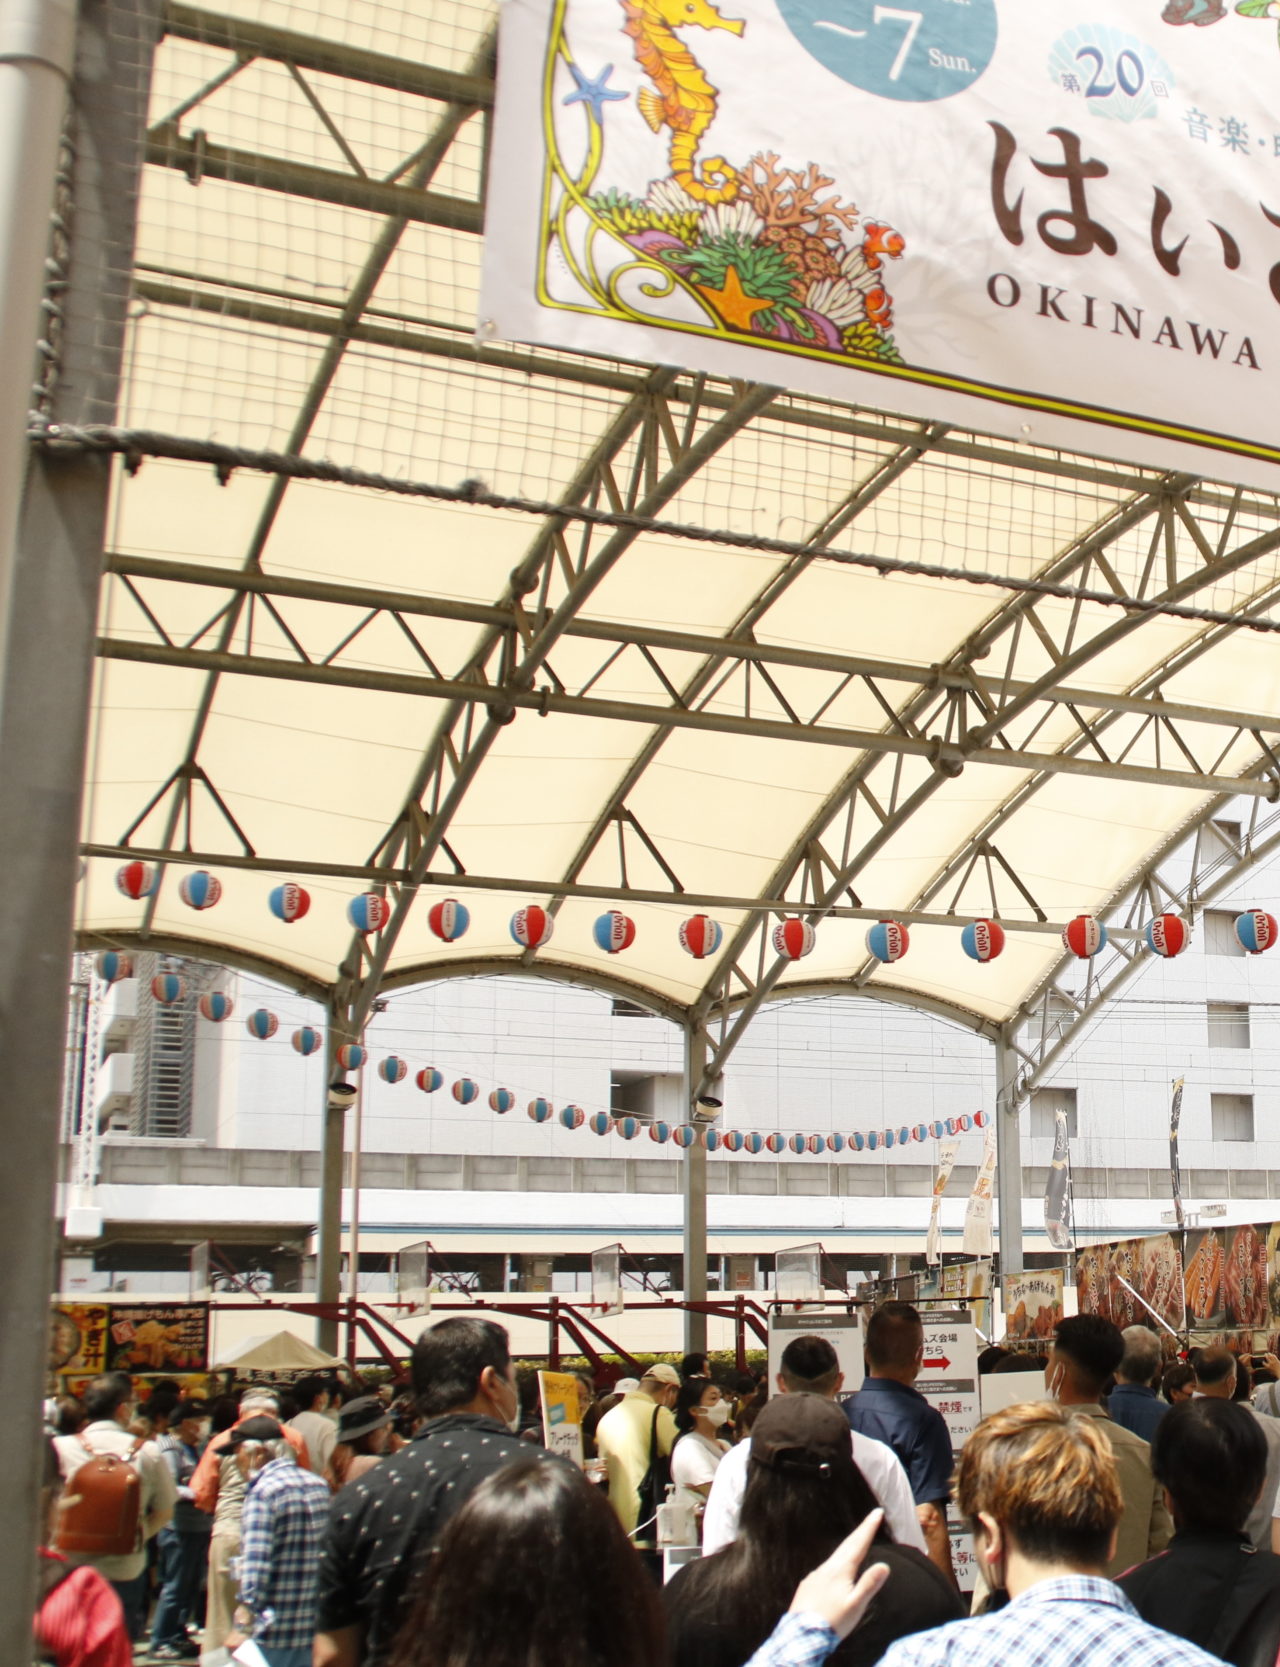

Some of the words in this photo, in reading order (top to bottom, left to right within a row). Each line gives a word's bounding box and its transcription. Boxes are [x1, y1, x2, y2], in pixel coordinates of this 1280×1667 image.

[928, 48, 976, 73] Sun.
[986, 273, 1261, 370] OKINAWA
[286, 887, 298, 911] Orion
[369, 896, 382, 922] Orion
[515, 910, 527, 934] Orion
[613, 915, 628, 940] Orion
[1152, 920, 1165, 948] Orion
[1255, 914, 1269, 942] Orion
[776, 925, 785, 950] Orion
[888, 927, 900, 954] Orion
[976, 925, 990, 952] Orion
